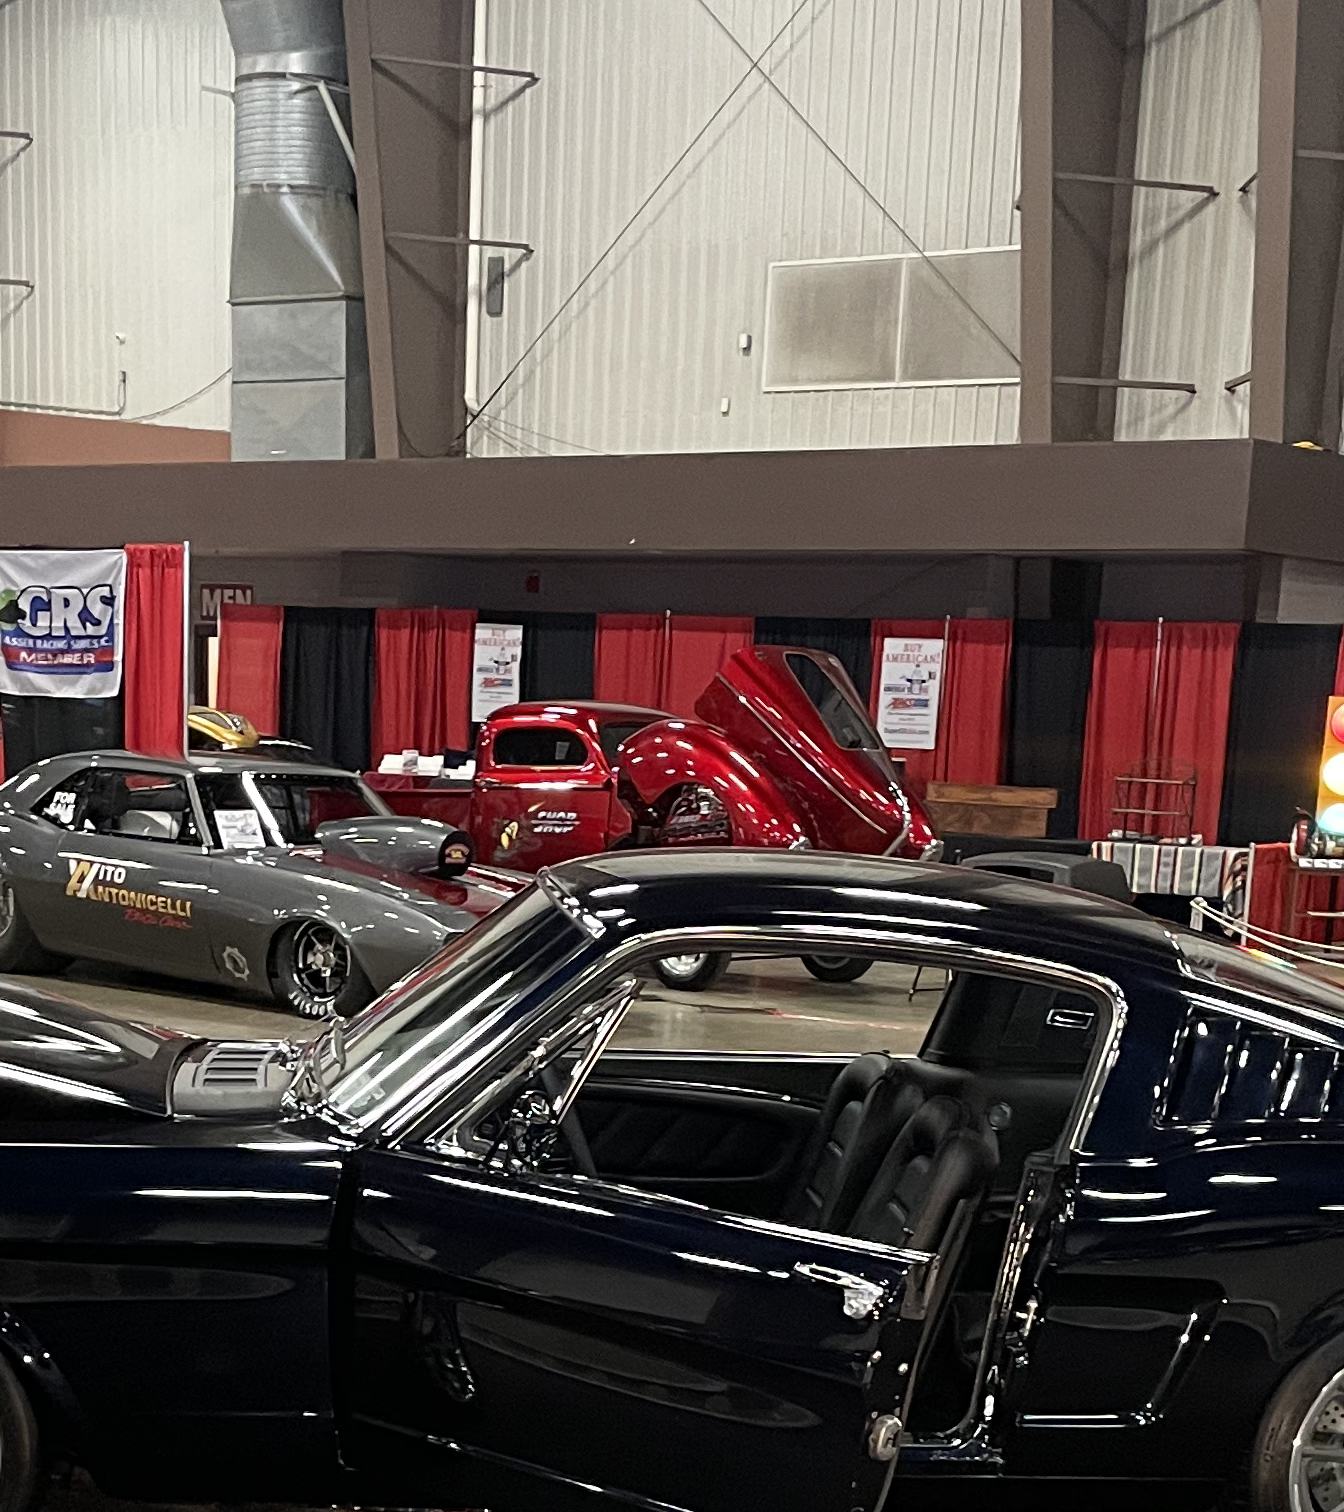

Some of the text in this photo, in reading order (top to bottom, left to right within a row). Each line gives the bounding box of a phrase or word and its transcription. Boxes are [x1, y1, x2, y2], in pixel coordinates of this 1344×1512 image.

[16, 584, 116, 638] GRS
[903, 643, 923, 653] BUY
[19, 651, 96, 665] MEMBER
[53, 791, 76, 804] FOR
